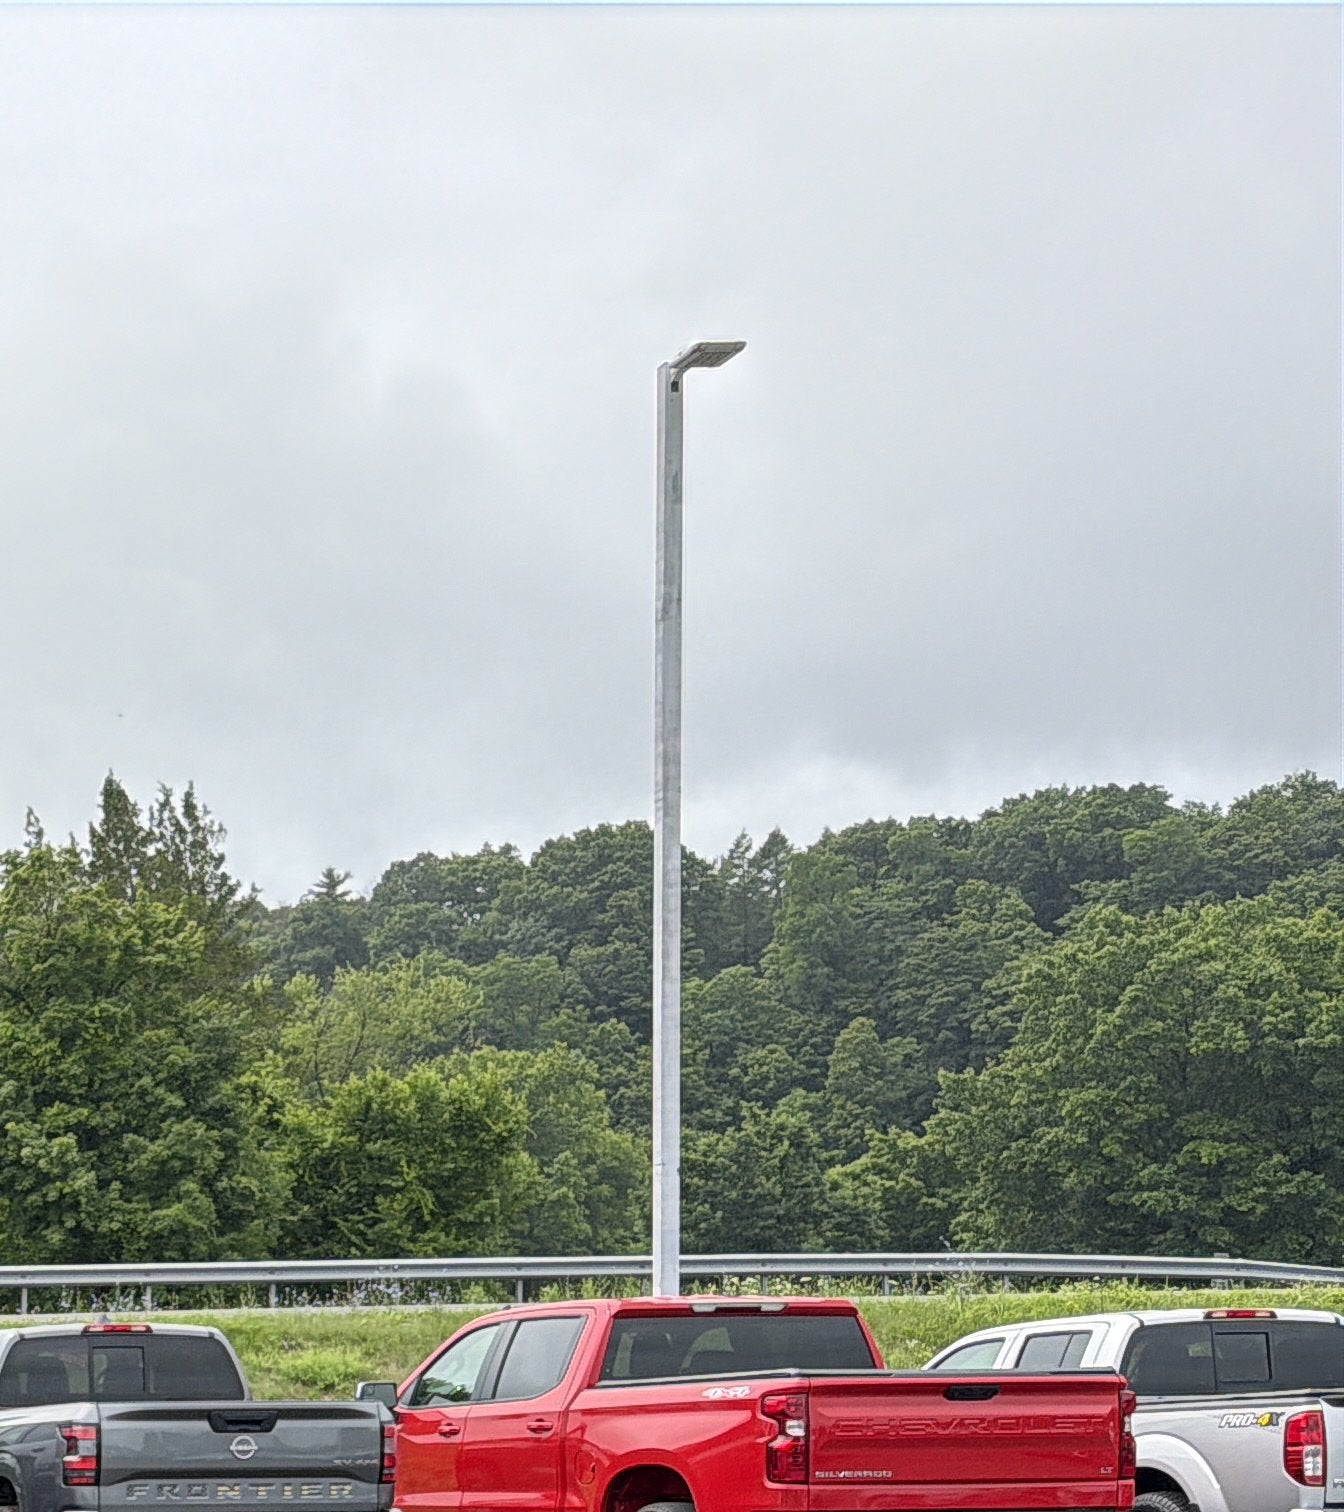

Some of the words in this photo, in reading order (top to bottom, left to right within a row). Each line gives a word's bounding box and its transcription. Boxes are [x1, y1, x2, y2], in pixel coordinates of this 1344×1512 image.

[835, 1418, 1103, 1437] CHEVROLET
[815, 1470, 893, 1478] SILVERADO
[126, 1483, 354, 1500] FRONTIER
